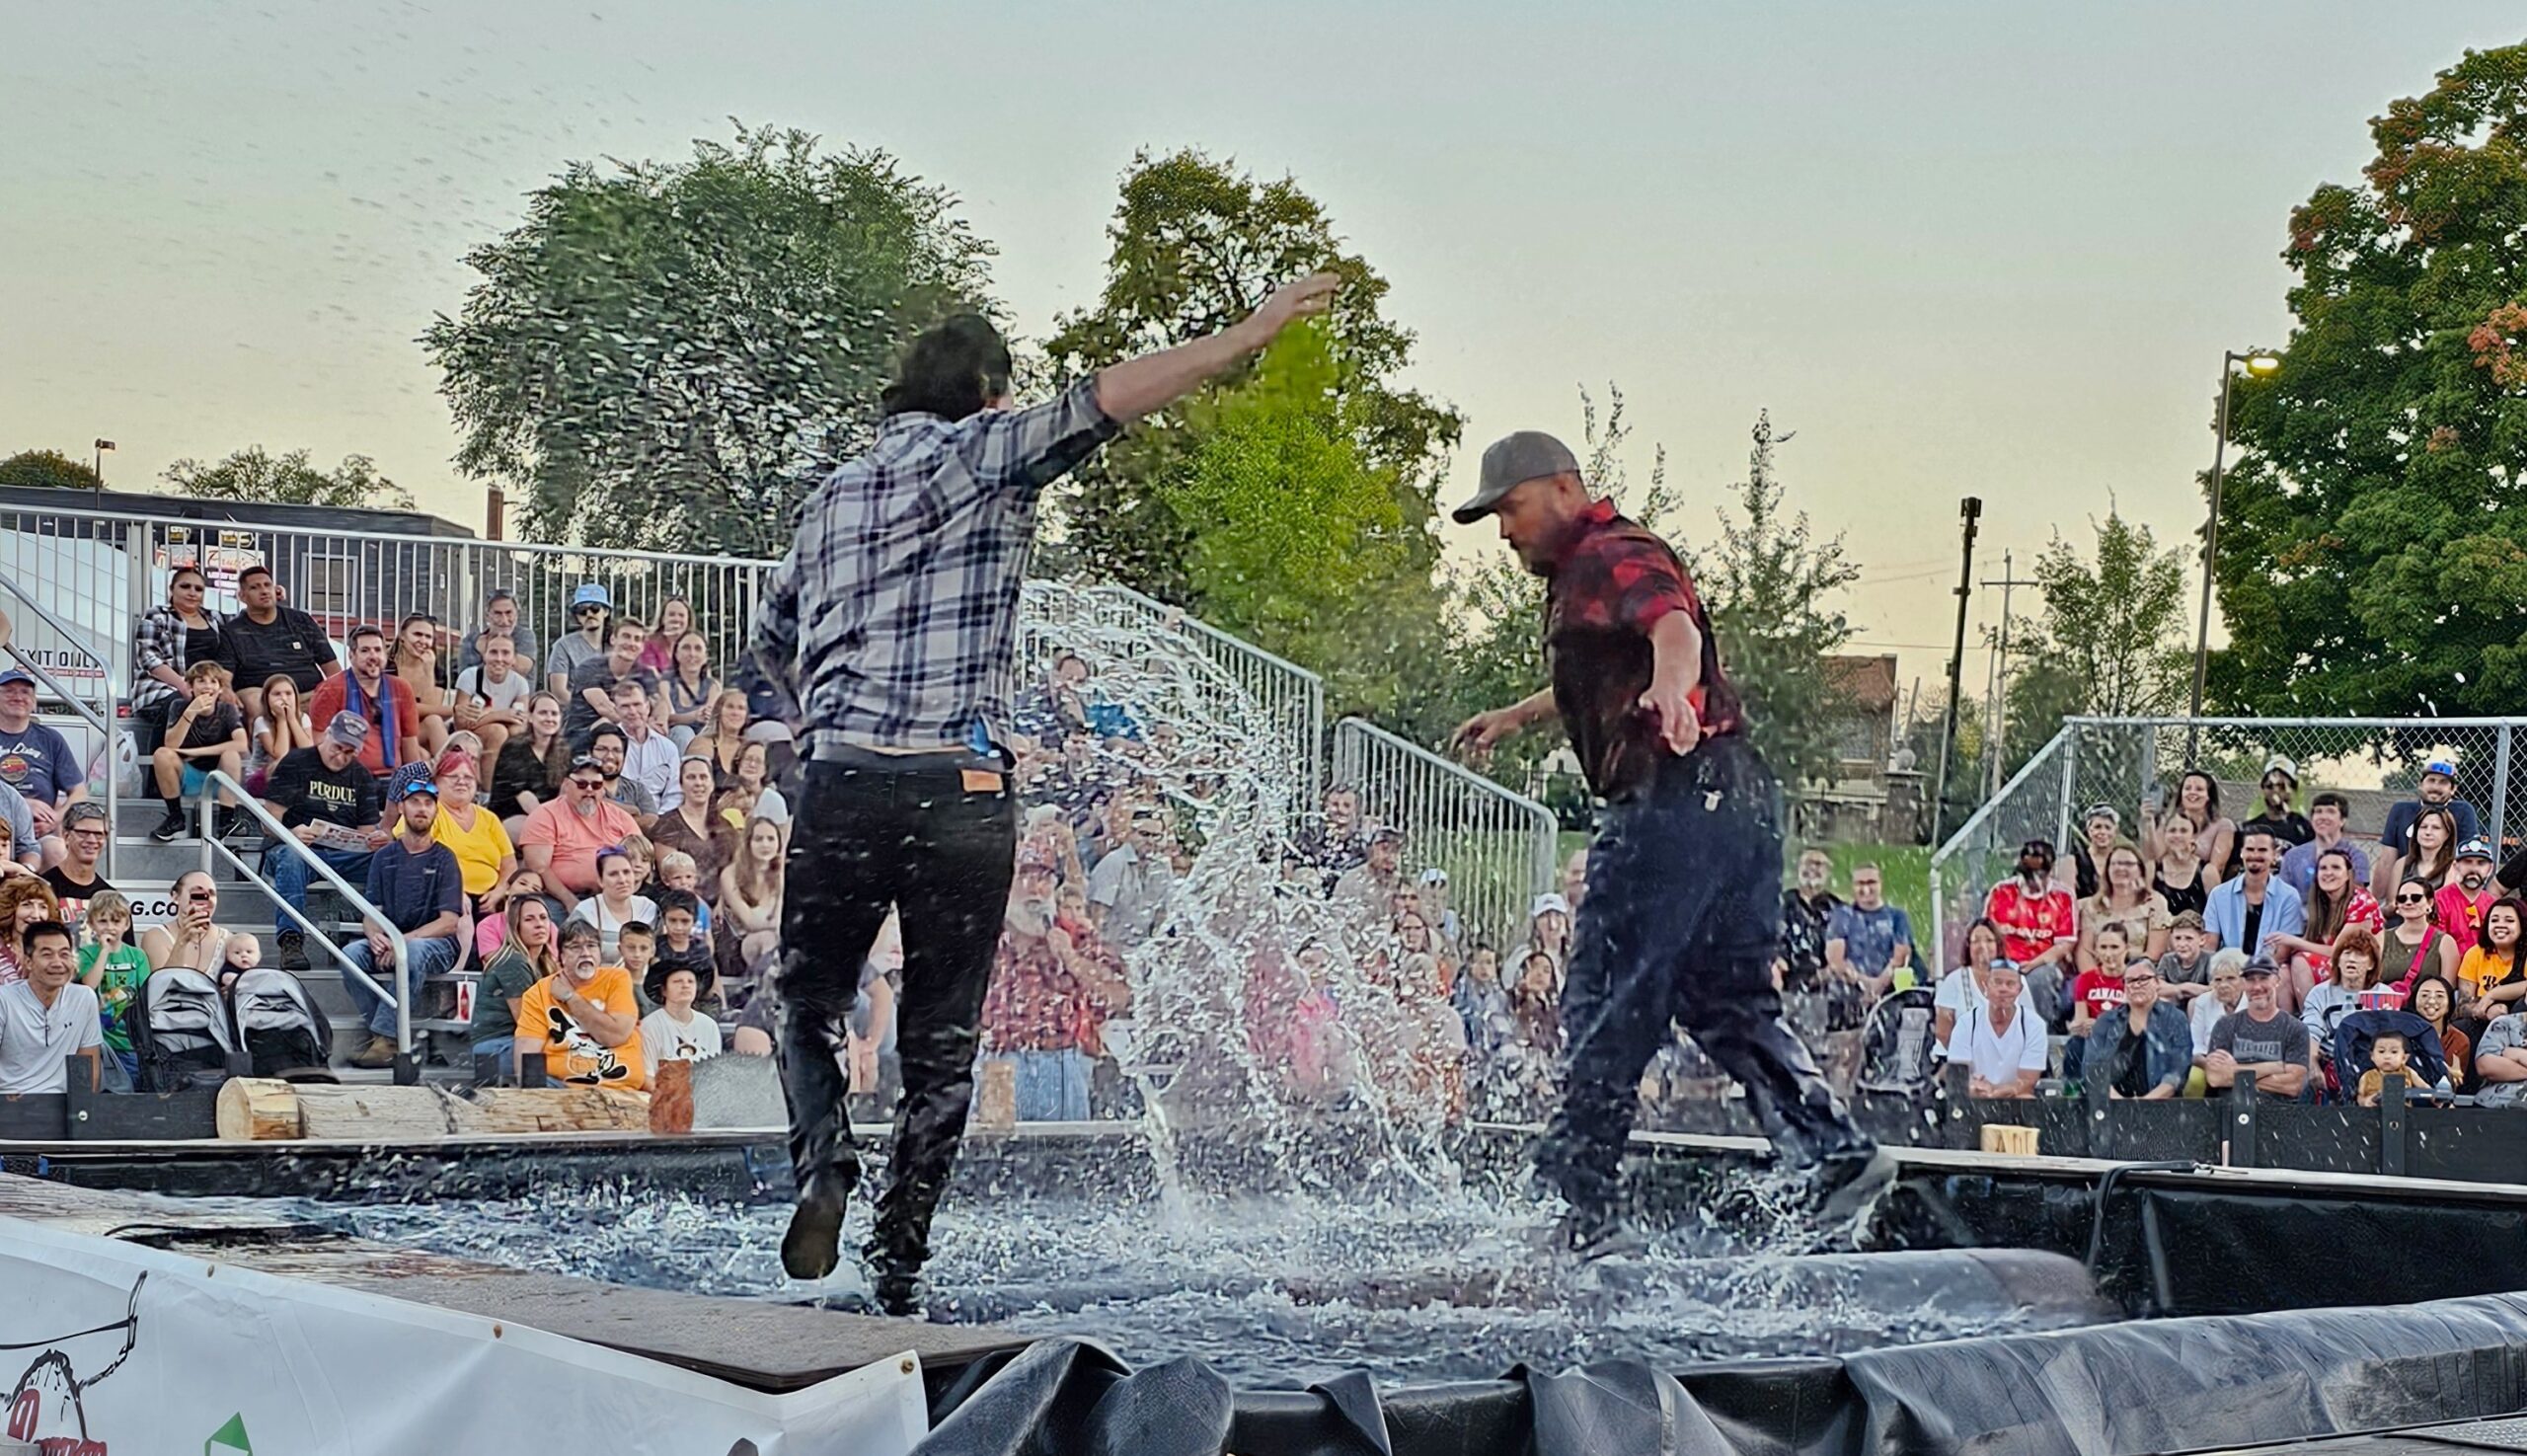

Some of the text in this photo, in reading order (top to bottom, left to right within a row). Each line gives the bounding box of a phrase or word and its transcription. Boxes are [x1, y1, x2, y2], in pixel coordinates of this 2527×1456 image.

[59, 651, 99, 668] ONL
[309, 780, 356, 803] PURDUE
[2088, 987, 2126, 1003] CANAD
